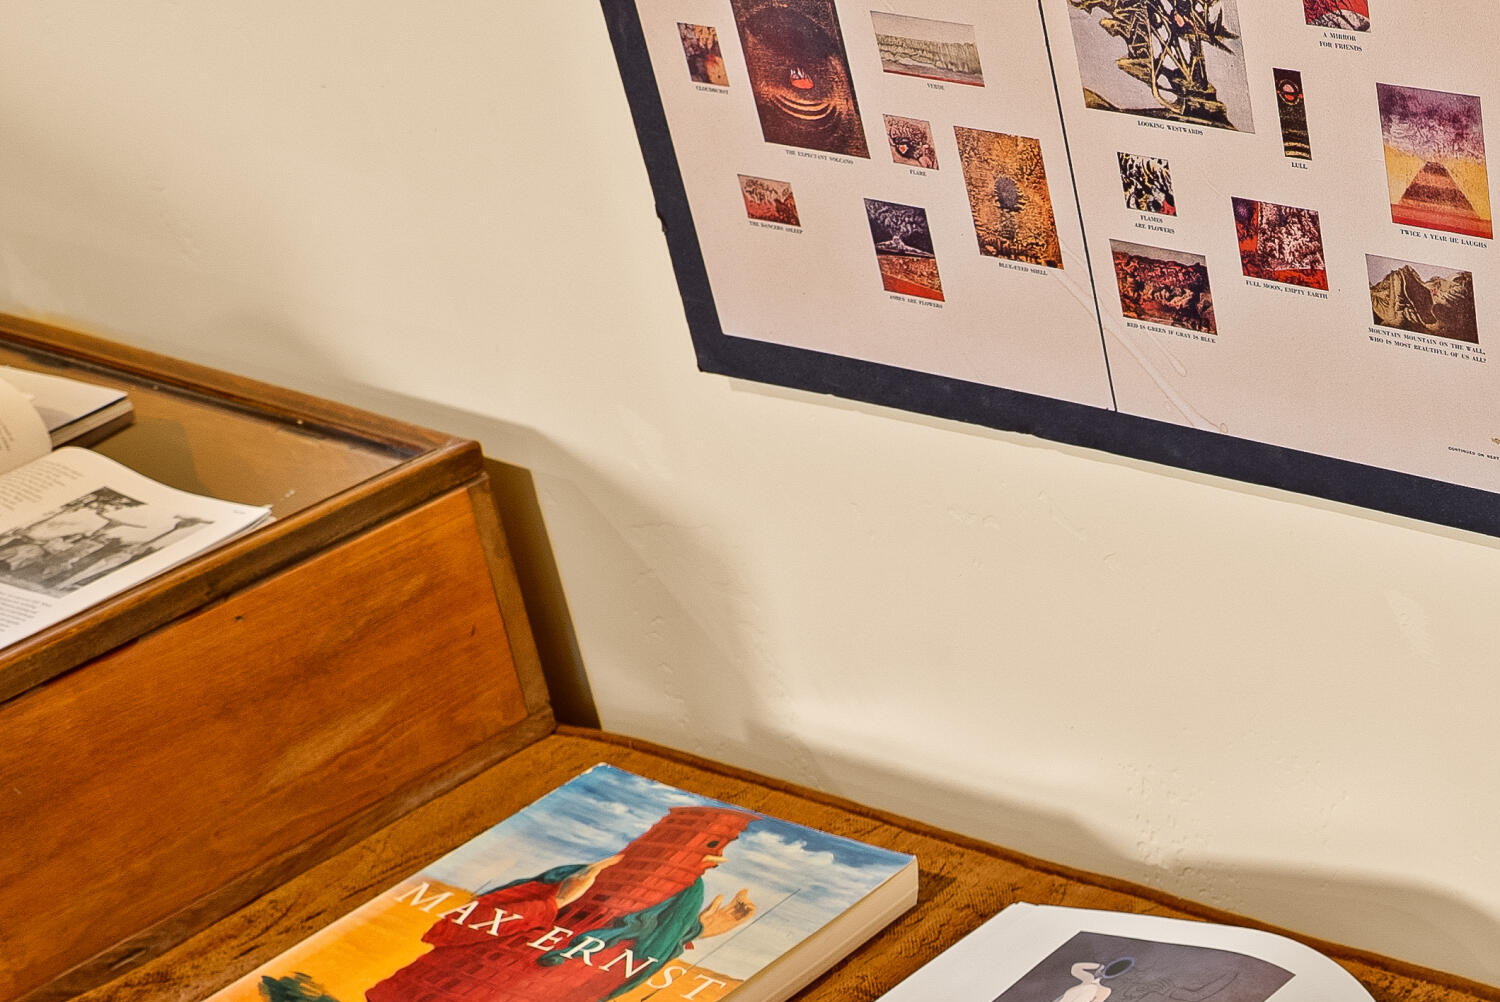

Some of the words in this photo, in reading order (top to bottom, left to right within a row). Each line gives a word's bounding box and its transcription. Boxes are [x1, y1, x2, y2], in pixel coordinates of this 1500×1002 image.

[1330, 32, 1356, 41] MIRROR
[1319, 40, 1332, 48] FOR
[1334, 43, 1362, 51] FRIENDS
[1137, 120, 1164, 129] LOOKING
[1166, 125, 1203, 135] WESTWARDS
[1291, 162, 1308, 170] LULL
[1400, 229, 1421, 237] TWICE
[1430, 233, 1447, 242] YEAR
[1461, 239, 1487, 248] LAUGHS
[1284, 287, 1304, 295] EMPTY
[1307, 290, 1328, 299] EARTH
[1368, 327, 1401, 338] MOUNTAIN
[1403, 334, 1437, 345] MOUNTAIN
[1394, 340, 1411, 348] MOST
[1413, 344, 1448, 356] BEAUTIFUL
[396, 881, 524, 937] MAX
[526, 925, 727, 1001] ERNST
